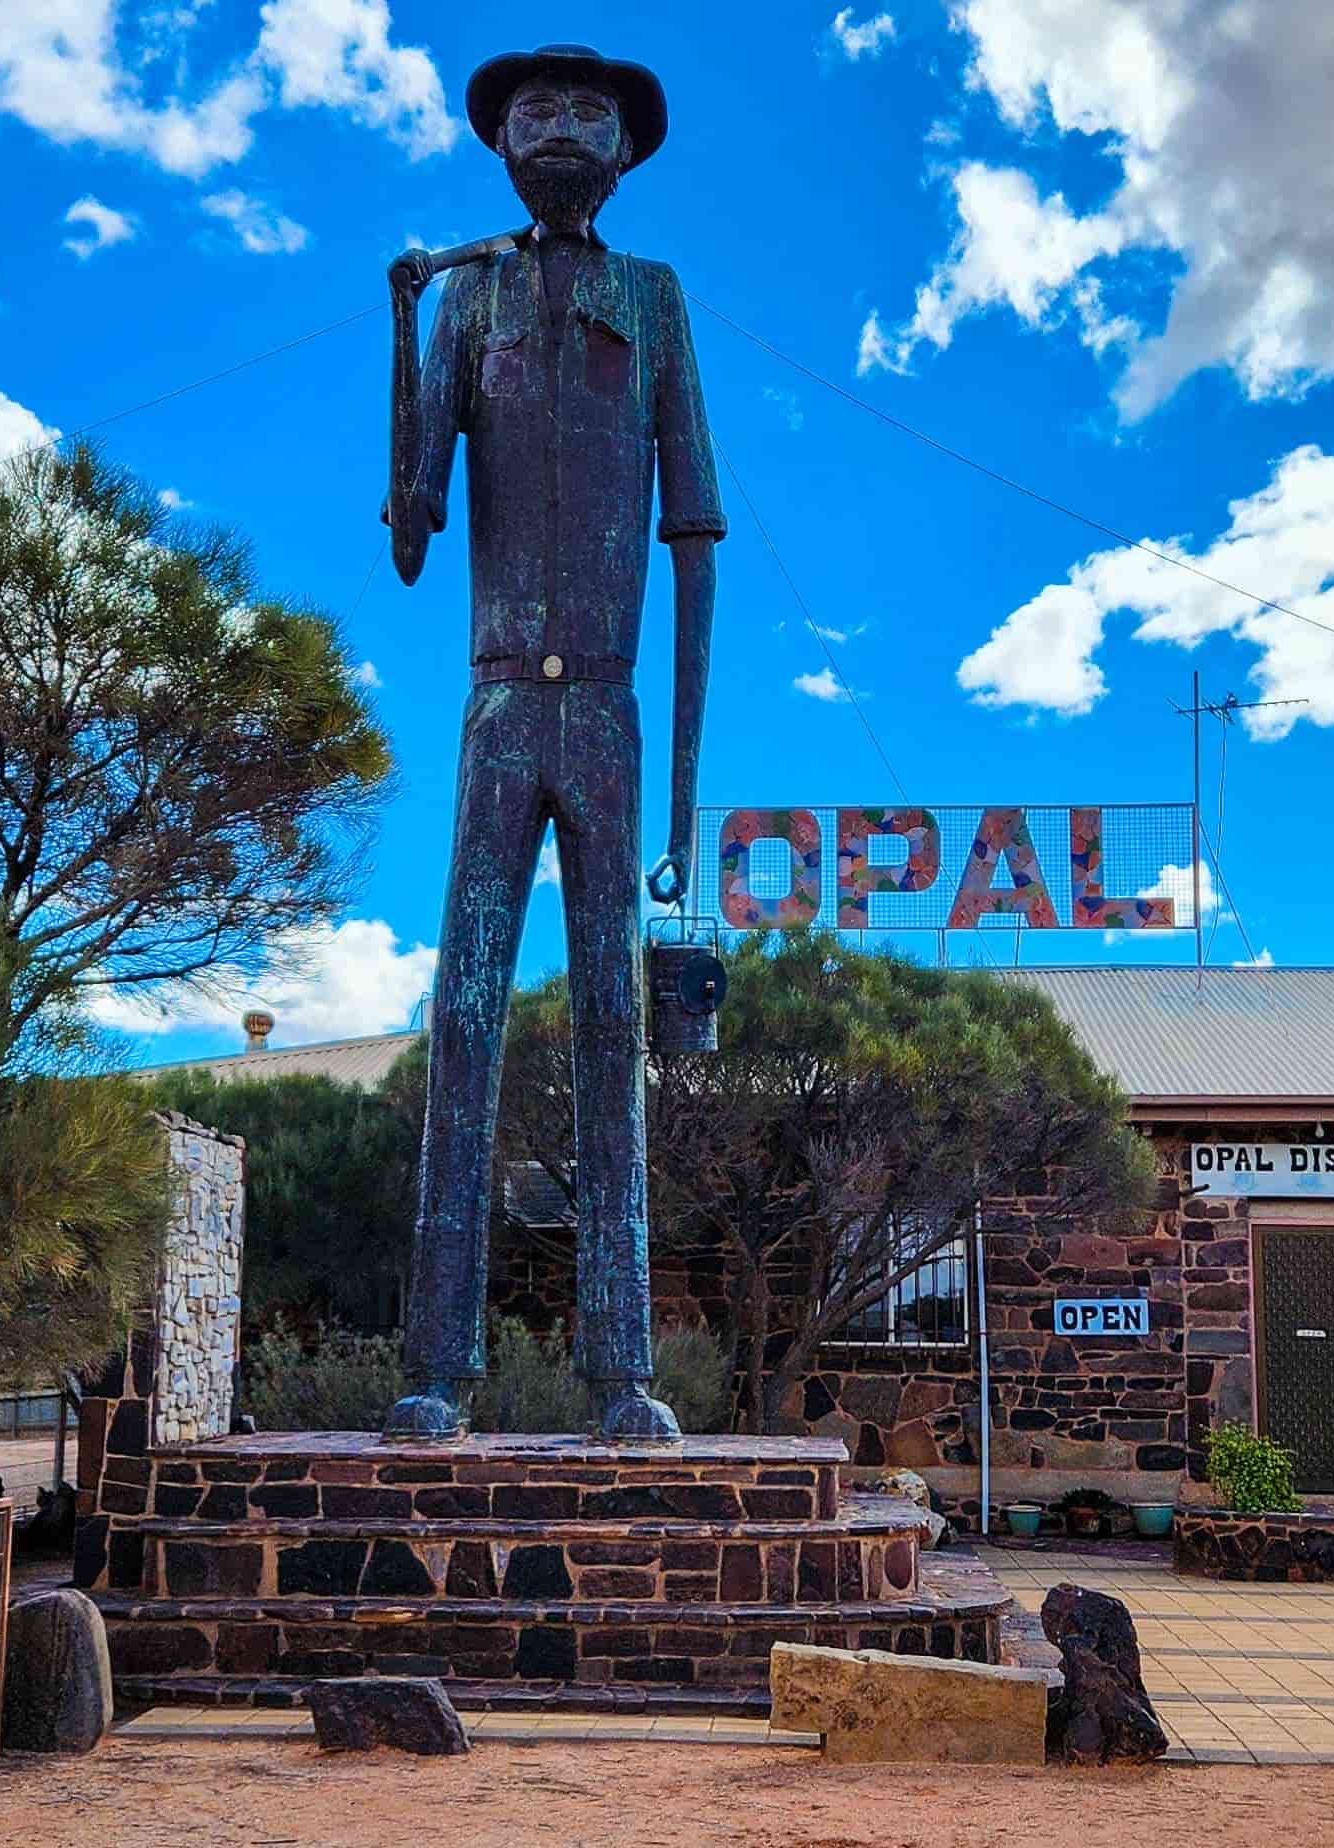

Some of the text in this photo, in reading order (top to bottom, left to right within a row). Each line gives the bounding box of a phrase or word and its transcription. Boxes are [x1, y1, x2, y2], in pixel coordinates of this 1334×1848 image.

[718, 807, 1175, 929] OPAL
[1195, 1147, 1274, 1172] OPAL
[1060, 1305, 1142, 1330] OPEN
